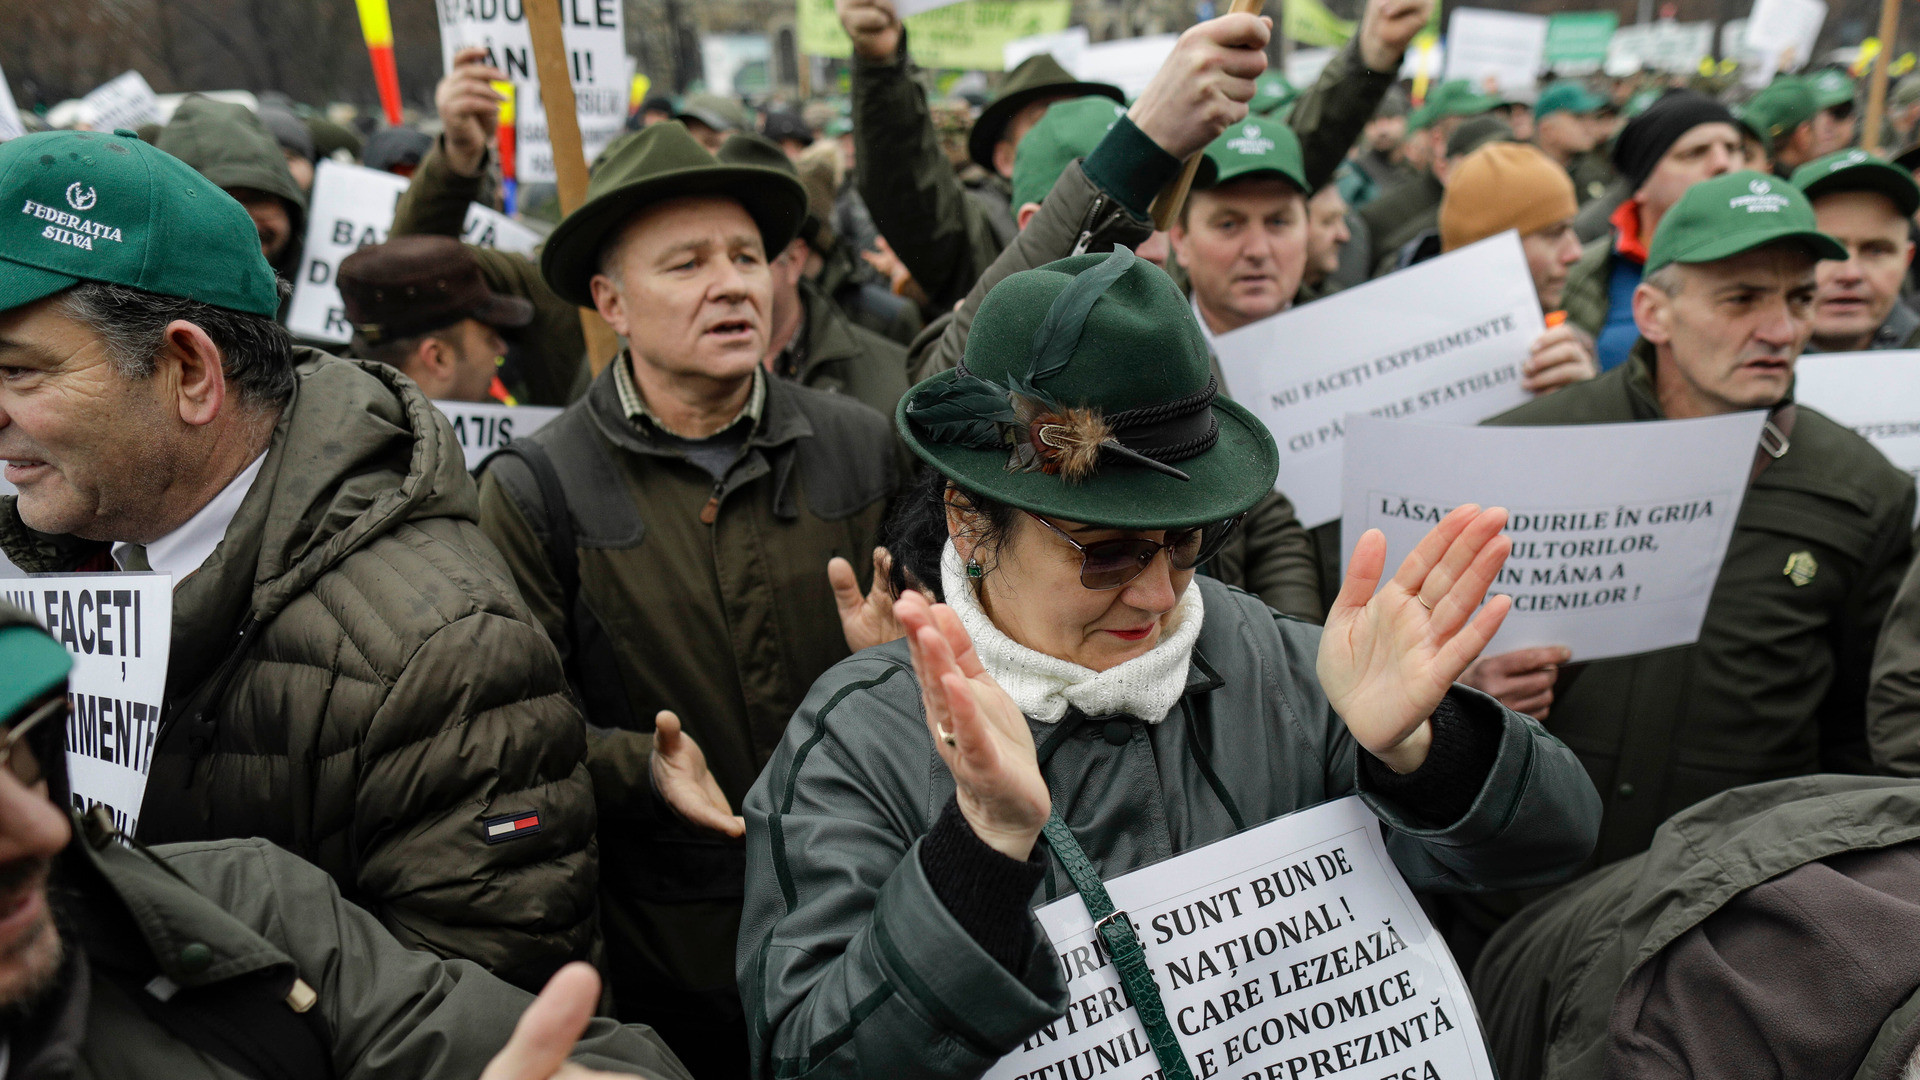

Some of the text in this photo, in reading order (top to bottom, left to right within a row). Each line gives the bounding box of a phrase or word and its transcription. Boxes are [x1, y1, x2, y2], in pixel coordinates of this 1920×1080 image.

[22, 200, 123, 243] FEDERAȚIA
[41, 225, 93, 251] SILVA
[1271, 313, 1517, 411] NU FACEȚI EXPERIMENTE
[1289, 431, 1315, 453] CU
[1418, 364, 1518, 409] STATULUI
[1614, 506, 1640, 529] ÎN
[1648, 500, 1714, 526] GRIJA
[1530, 562, 1606, 586] MÂNA
[1607, 562, 1626, 579] A
[44, 589, 141, 682] FACEȚI
[65, 692, 158, 776] IMENTE
[1151, 886, 1243, 944] SUNT
[1249, 860, 1317, 908] BUN
[1315, 848, 1353, 882] DE
[1165, 904, 1342, 990] NAȚIONAL
[1338, 896, 1355, 922] !
[1177, 979, 1264, 1037] CARE
[1269, 917, 1408, 999] LEZEAZĂ
[1223, 970, 1417, 1067] ECONOMICE
